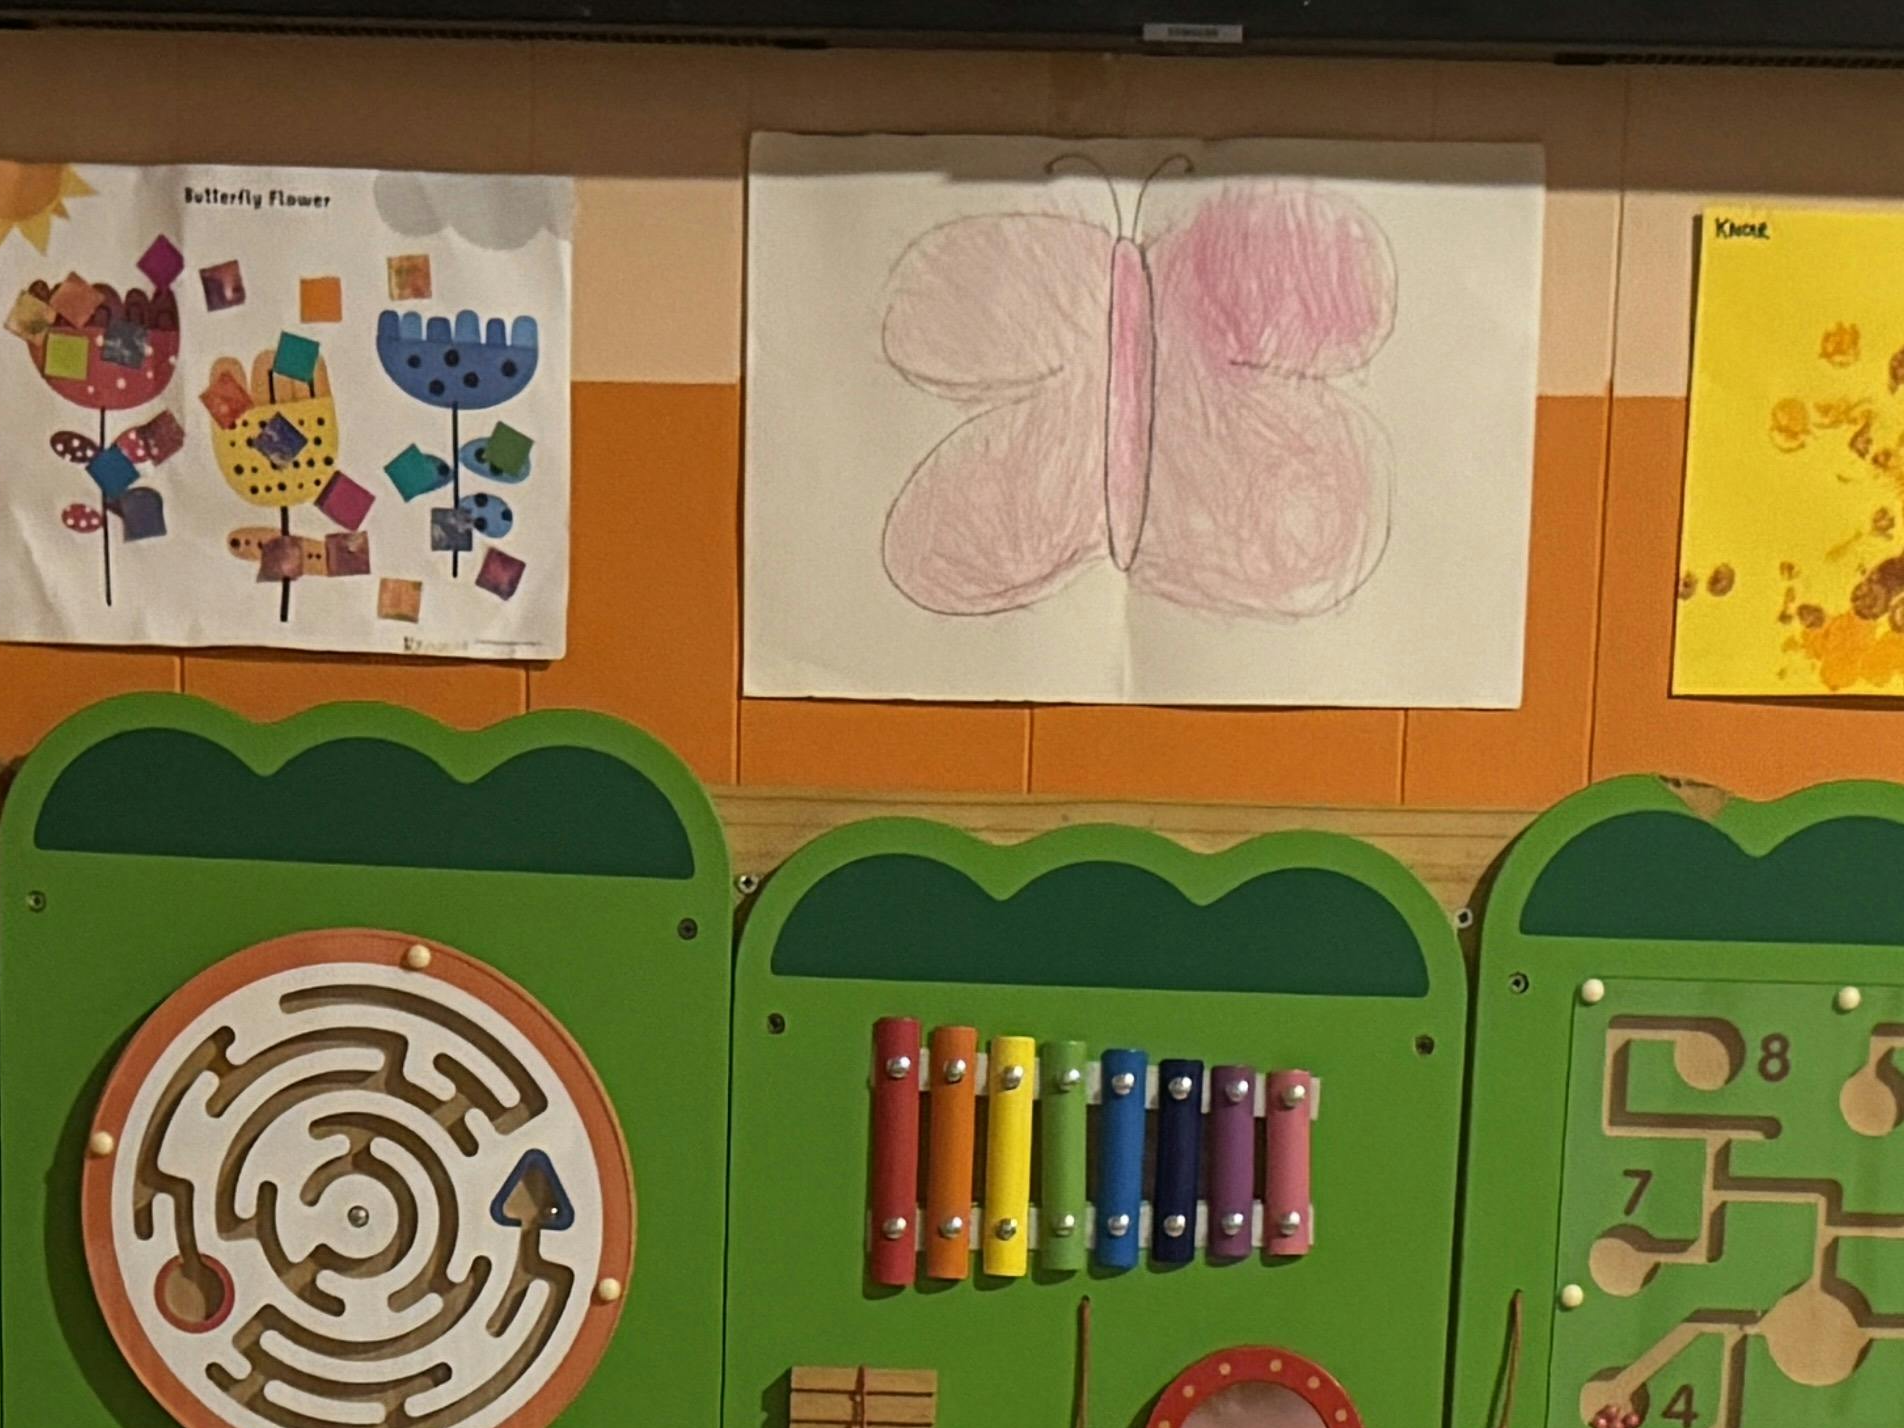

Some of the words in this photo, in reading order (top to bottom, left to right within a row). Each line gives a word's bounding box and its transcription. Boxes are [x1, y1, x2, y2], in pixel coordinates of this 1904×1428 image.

[184, 187, 262, 209] Butterfly
[269, 190, 331, 208] Flower
[1757, 1033, 1791, 1083] 8
[1622, 1168, 1654, 1216] 7
